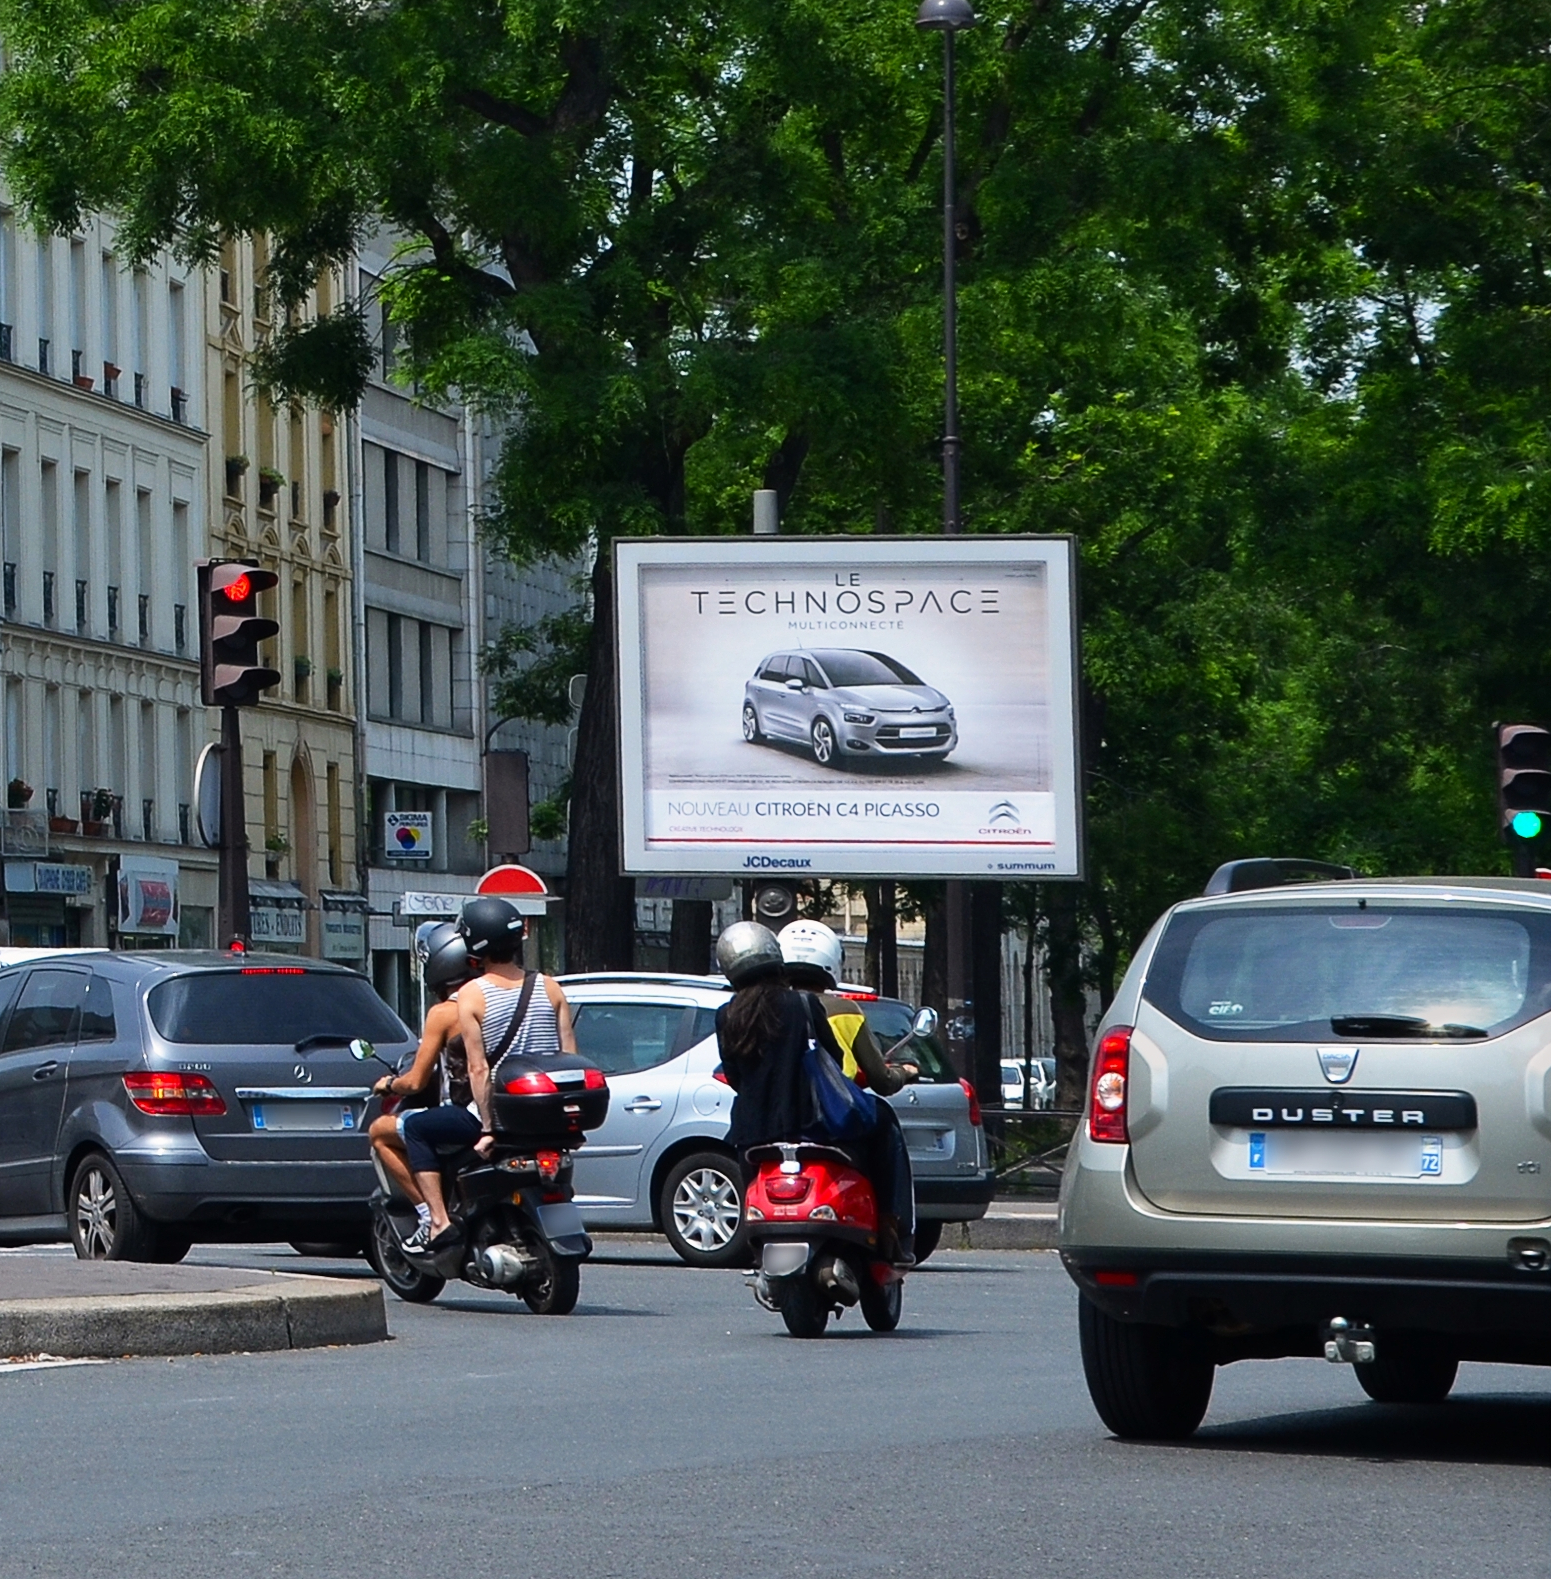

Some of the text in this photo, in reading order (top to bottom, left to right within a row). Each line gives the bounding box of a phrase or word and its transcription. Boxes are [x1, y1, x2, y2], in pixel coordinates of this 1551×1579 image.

[835, 573, 860, 587] LE
[690, 589, 1000, 615] TECHNOSPACE
[788, 620, 904, 630] MULTICONNECTÉ
[668, 799, 940, 817] NOUVEAU CITROËN C4 PICASSO
[399, 813, 428, 822] SIGMA
[743, 856, 811, 868] JCDecaux
[997, 862, 1055, 870] summum
[1252, 1108, 1425, 1124] DUSTER
[1421, 1155, 1438, 1170] 72
